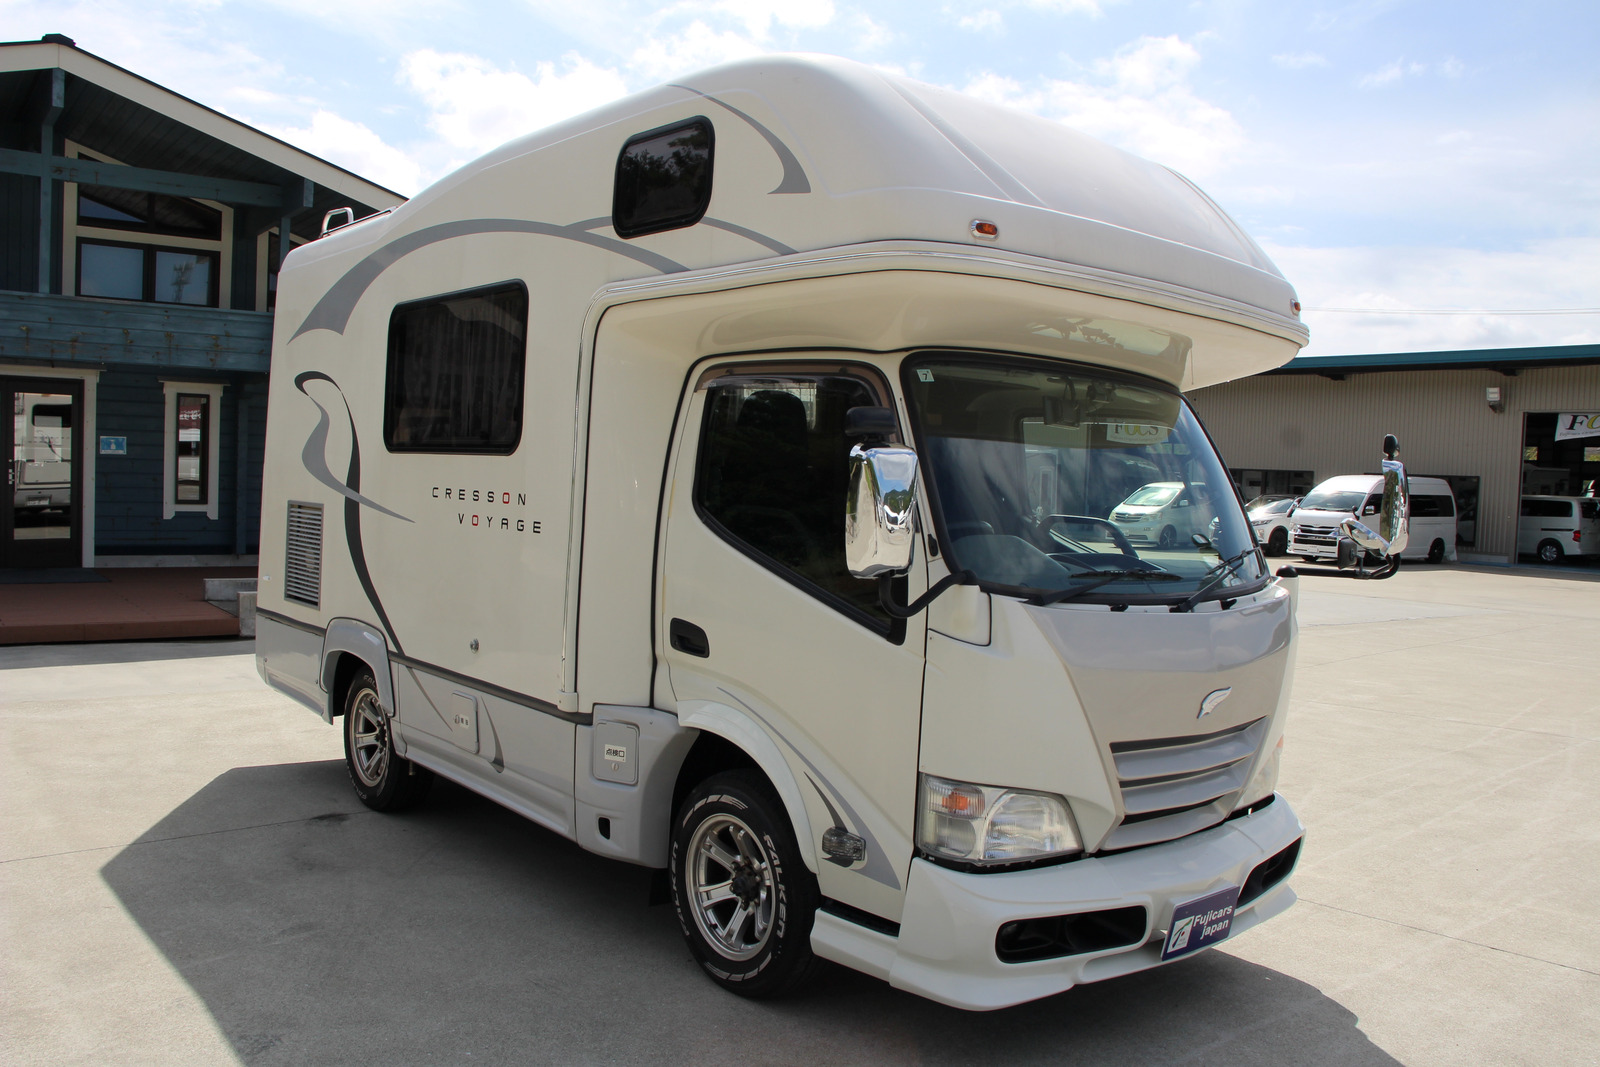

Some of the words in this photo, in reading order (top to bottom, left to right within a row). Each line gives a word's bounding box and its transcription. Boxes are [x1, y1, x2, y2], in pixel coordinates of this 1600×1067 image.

[432, 487, 526, 506] CRESSON
[458, 513, 541, 534] VOYAGE
[606, 748, 625, 758] 点検口
[763, 833, 787, 939] FALKEN
[1193, 905, 1233, 927] Fujicars
[1200, 919, 1229, 940] japan
